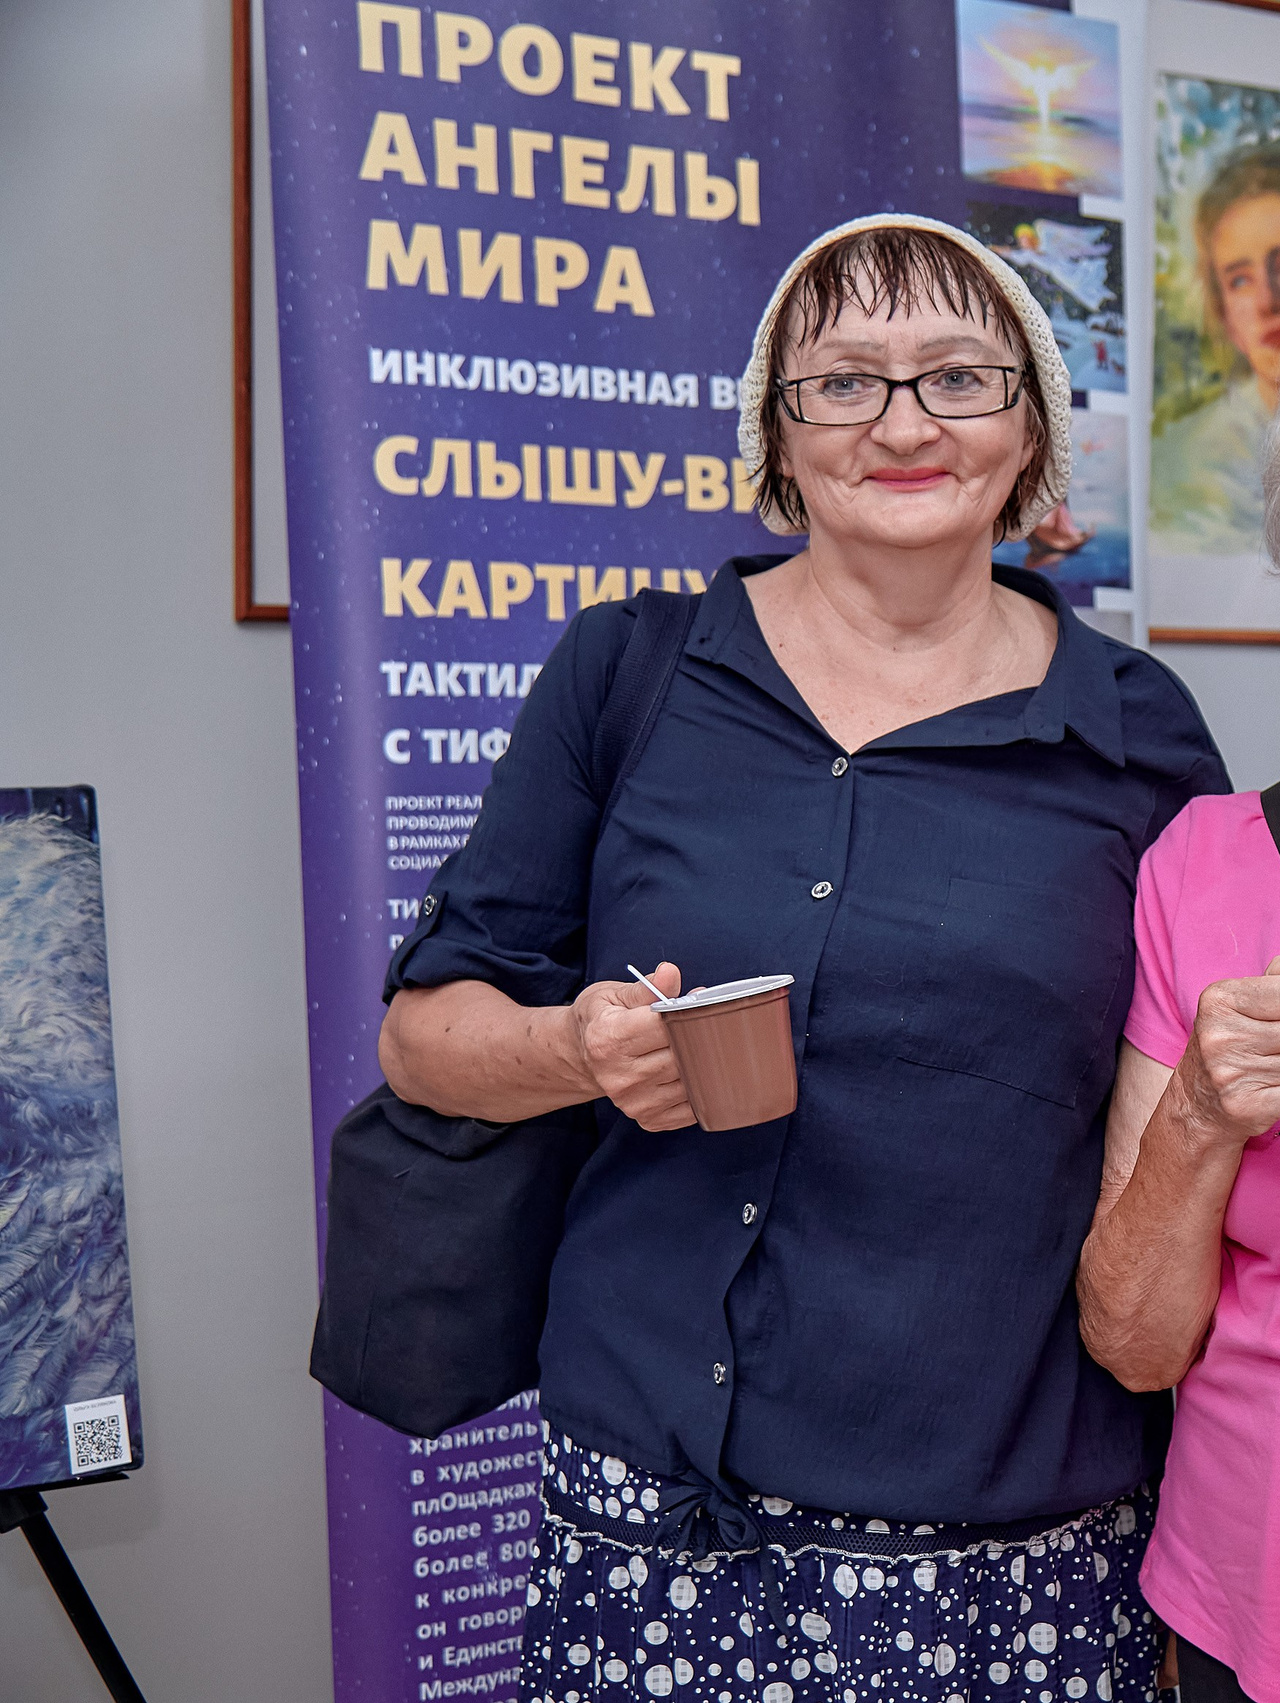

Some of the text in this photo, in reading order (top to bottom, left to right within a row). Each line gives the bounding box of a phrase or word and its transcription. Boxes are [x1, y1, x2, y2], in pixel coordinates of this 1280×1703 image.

[357, 1, 742, 122] ПРОЕКТ
[359, 111, 762, 227] АНГЕЛЫ
[365, 218, 656, 318] МИРА
[369, 347, 743, 411] ИНКЛЮЗИВНАЯ В
[383, 728, 411, 765] С
[386, 795, 443, 811] ПРОЕКТ
[386, 814, 479, 832] ПРОВОДИМ
[387, 835, 399, 851] В
[399, 834, 461, 851] РАМКАХ
[413, 1509, 530, 1547] более 320
[415, 1551, 488, 1578] более
[442, 1572, 531, 1604] конкре
[416, 1604, 527, 1639] он говор
[418, 1654, 433, 1671] и
